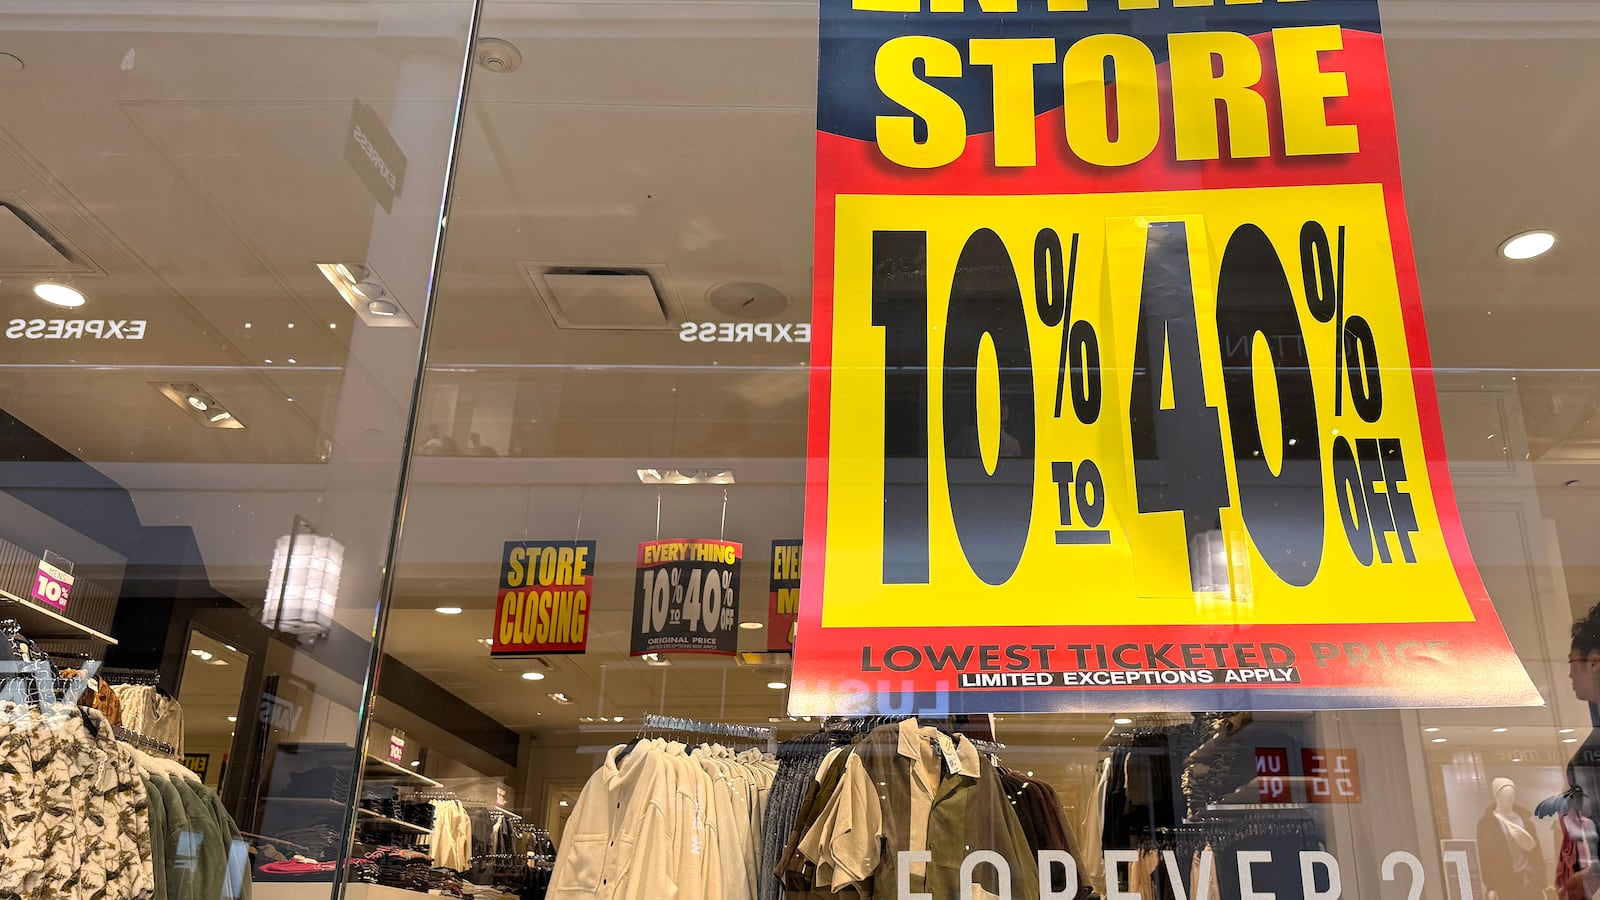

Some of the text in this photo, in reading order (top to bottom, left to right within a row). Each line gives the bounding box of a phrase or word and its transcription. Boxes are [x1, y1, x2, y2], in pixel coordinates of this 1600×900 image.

[874, 25, 1360, 168] STORE
[1052, 460, 1108, 529] TO
[1332, 435, 1419, 566] OFF
[507, 546, 588, 587] STORE
[644, 543, 735, 565] EVERYTHING
[499, 590, 587, 646] CLOSING
[670, 611, 681, 621] TO
[720, 609, 735, 632] OFF
[648, 637, 717, 645] ORIGINAL PRICE
[861, 644, 1055, 672] LOWEST
[1068, 643, 1296, 671] TICKETED
[962, 667, 1293, 688] LIMITED EXCEPTIONS APPLY
